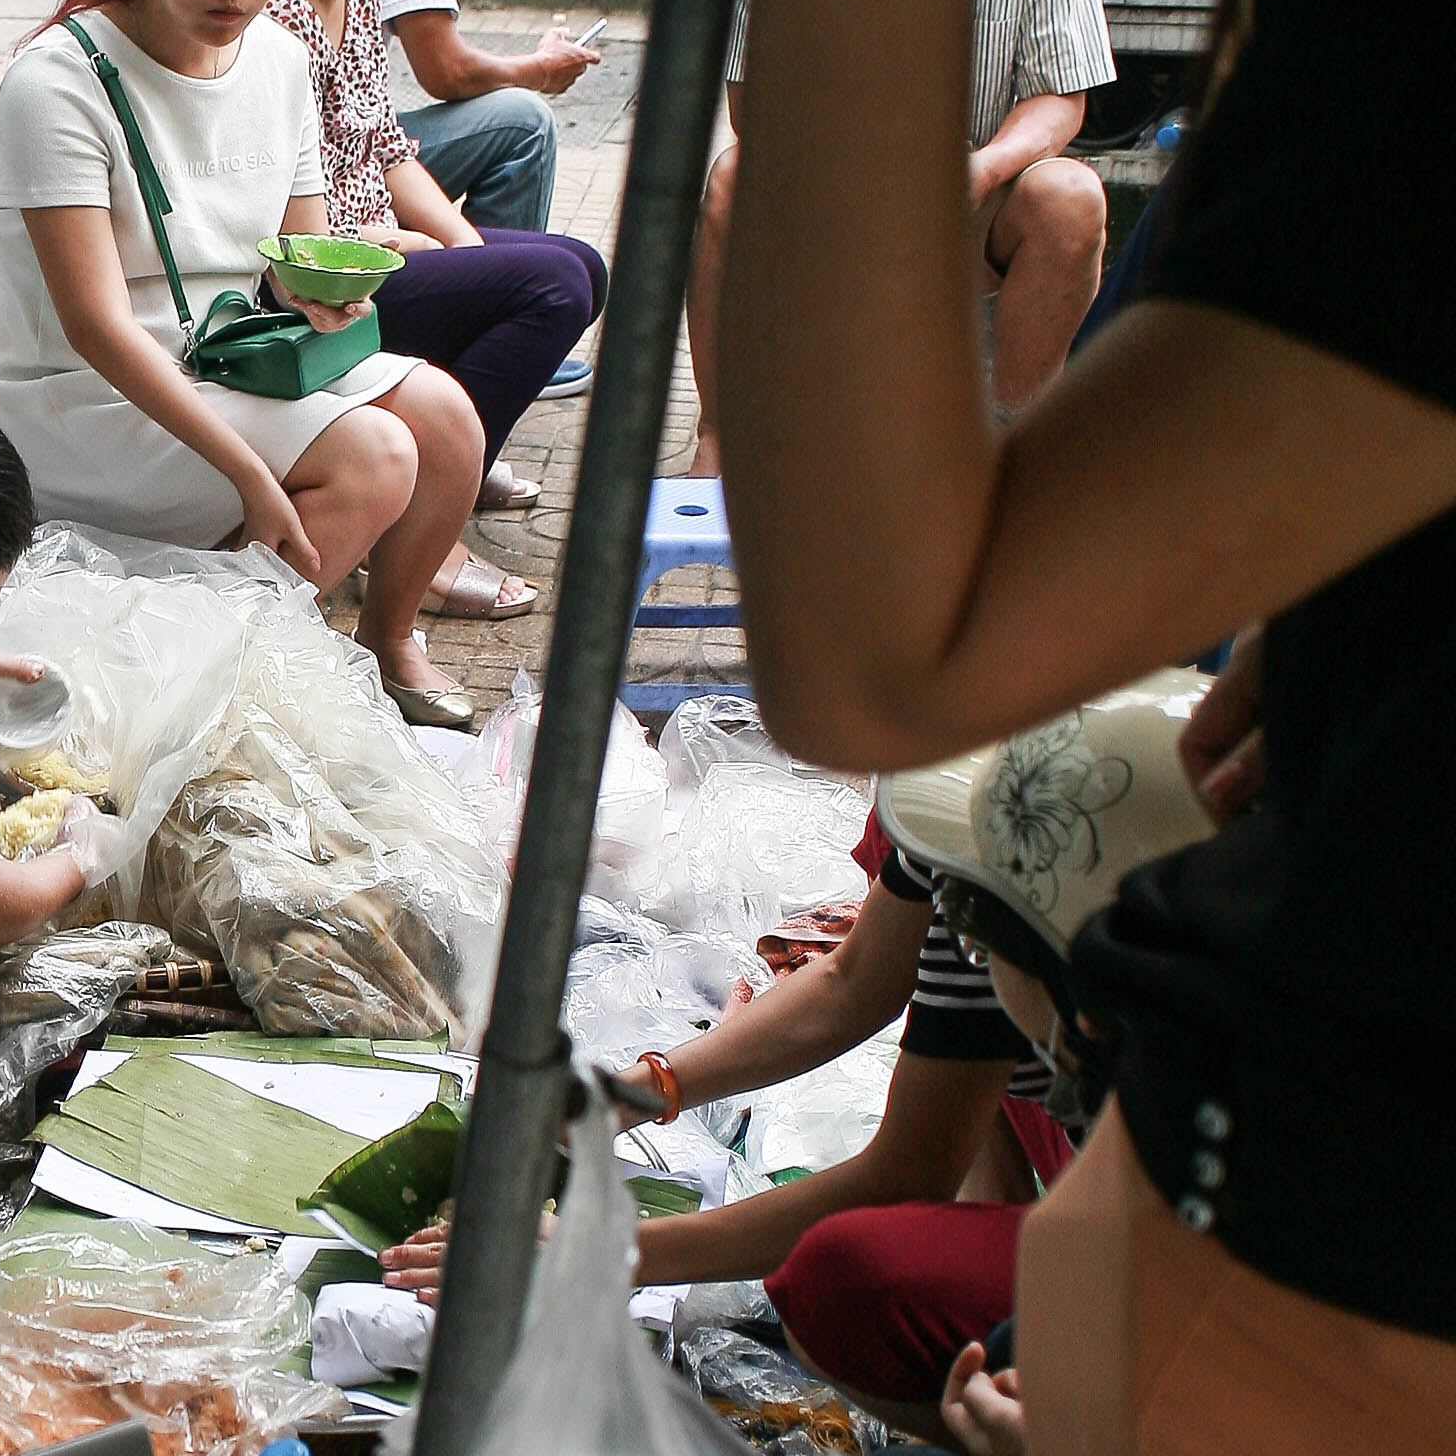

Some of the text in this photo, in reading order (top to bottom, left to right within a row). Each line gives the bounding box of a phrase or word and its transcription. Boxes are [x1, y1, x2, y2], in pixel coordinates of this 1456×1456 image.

[157, 149, 277, 177] NHING TO SAY
